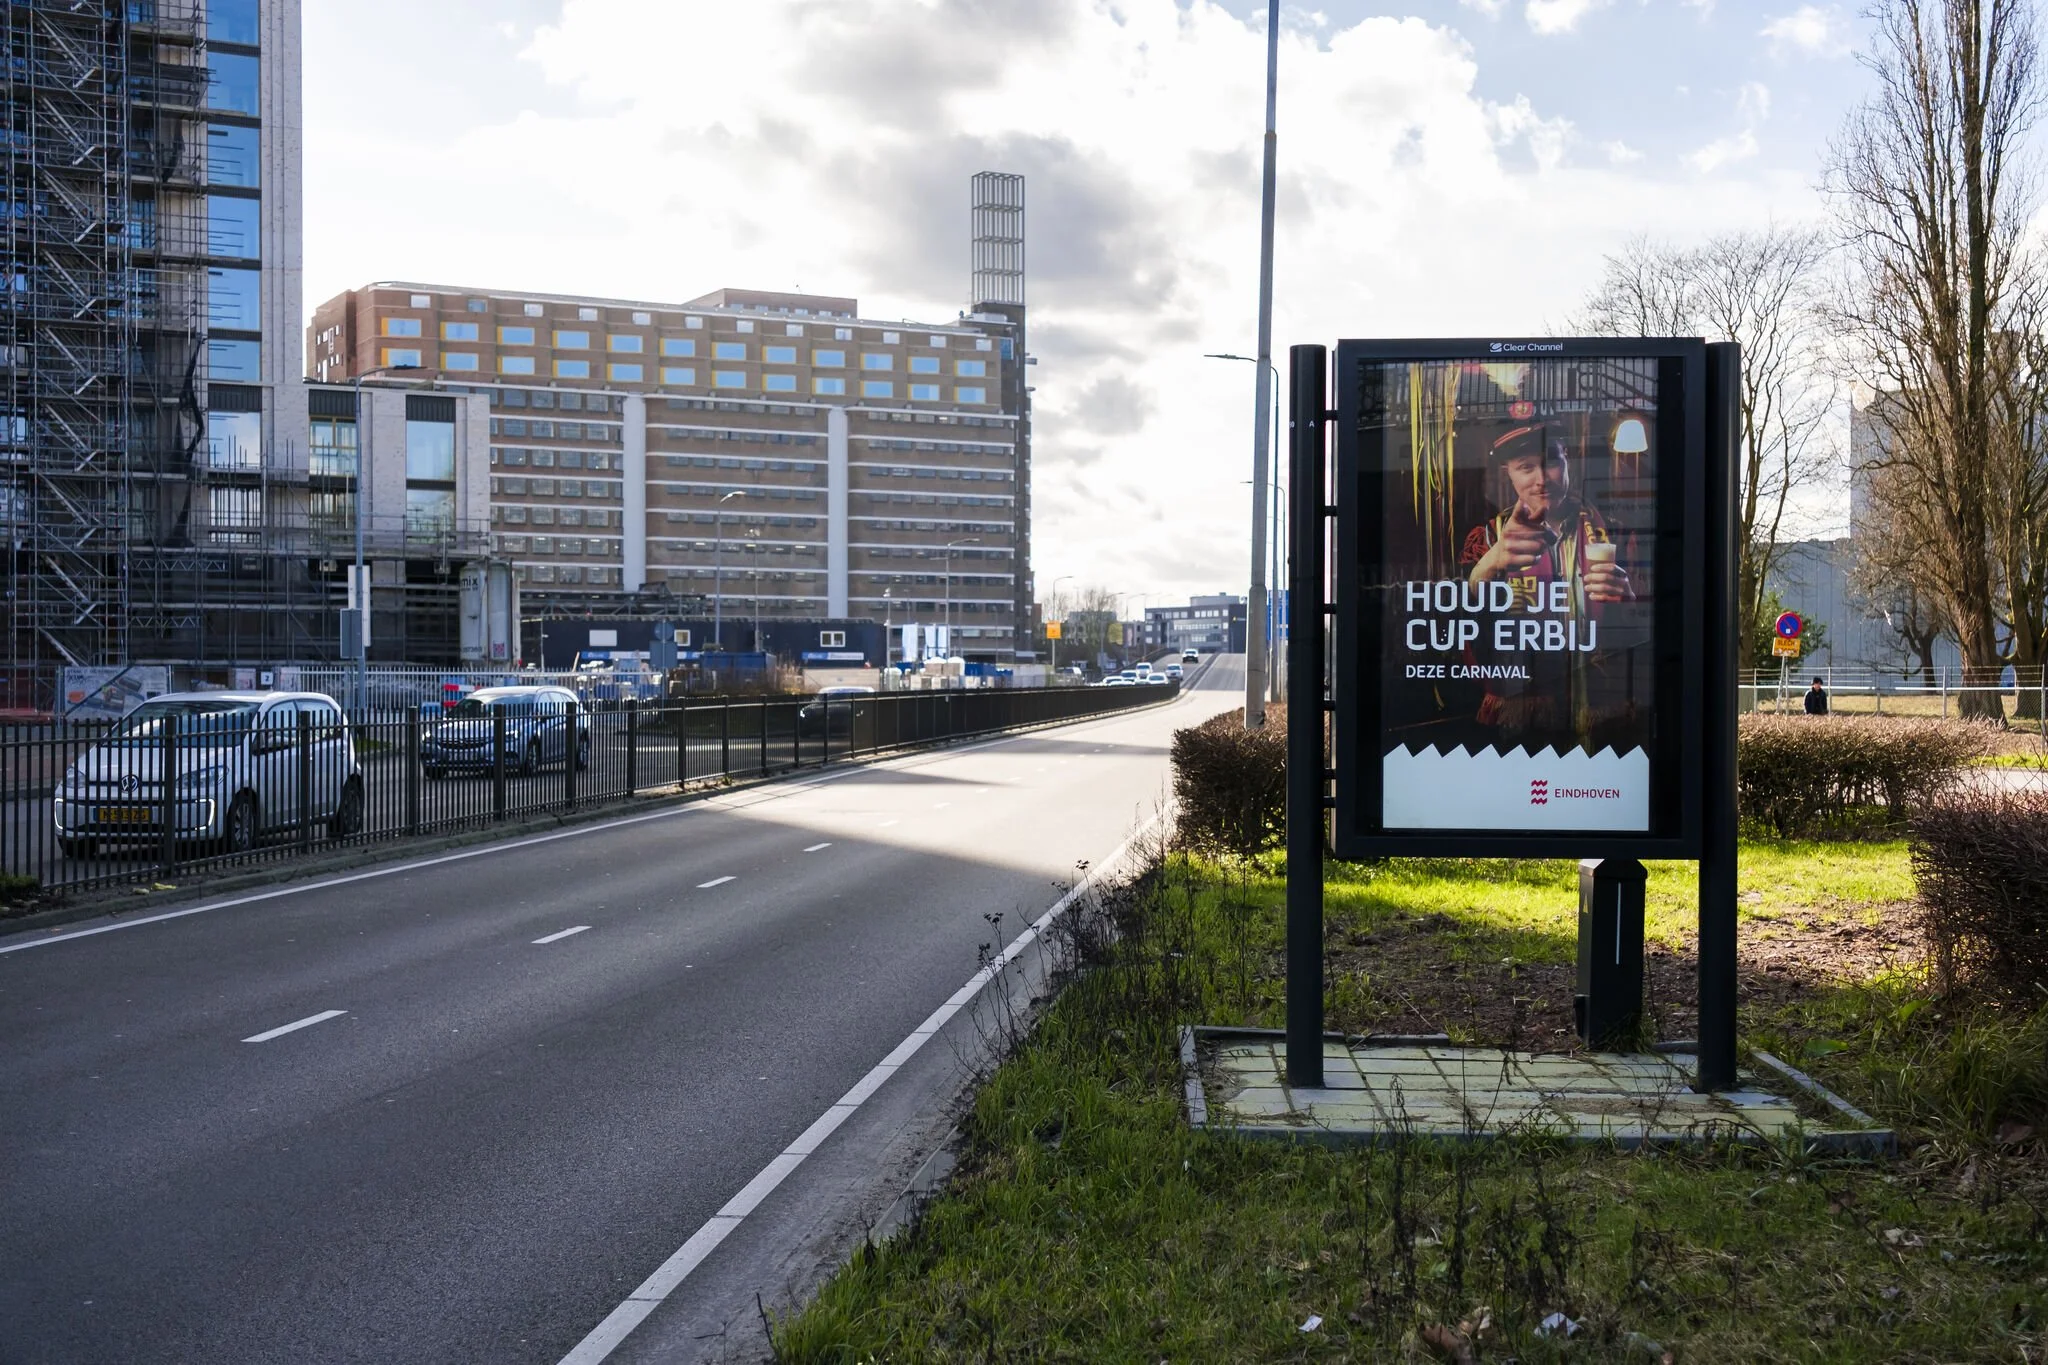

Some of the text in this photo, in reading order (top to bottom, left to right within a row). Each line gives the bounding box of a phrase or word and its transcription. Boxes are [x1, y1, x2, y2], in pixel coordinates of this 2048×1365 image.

[1502, 342, 1563, 352] Clear Channel
[1406, 580, 1571, 613] HOUD JE
[1406, 618, 1597, 652] CUP ERBIJ
[1405, 664, 1531, 679] DEZE CARNAVAL
[1554, 788, 1621, 799] EINDHOVEN
